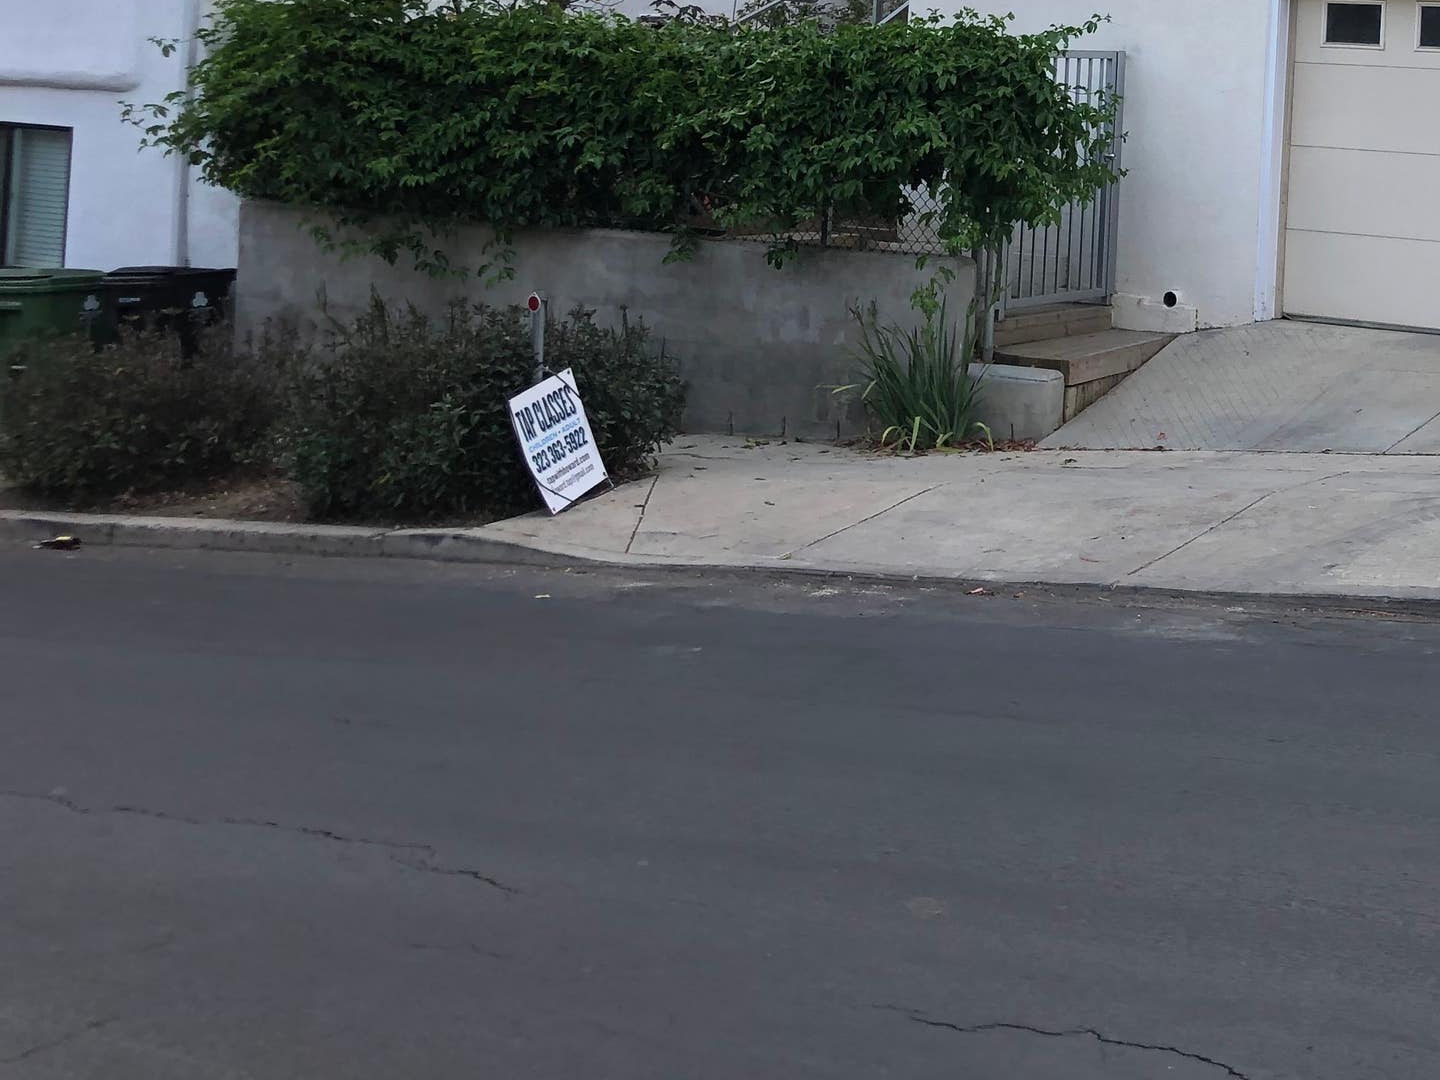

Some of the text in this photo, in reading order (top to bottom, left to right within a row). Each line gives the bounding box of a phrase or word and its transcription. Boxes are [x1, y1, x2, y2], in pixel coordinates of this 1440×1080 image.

[515, 384, 577, 442] TAP CLASSES
[529, 432, 558, 453] CHILDREN
[532, 426, 589, 473] 323 363-5922
